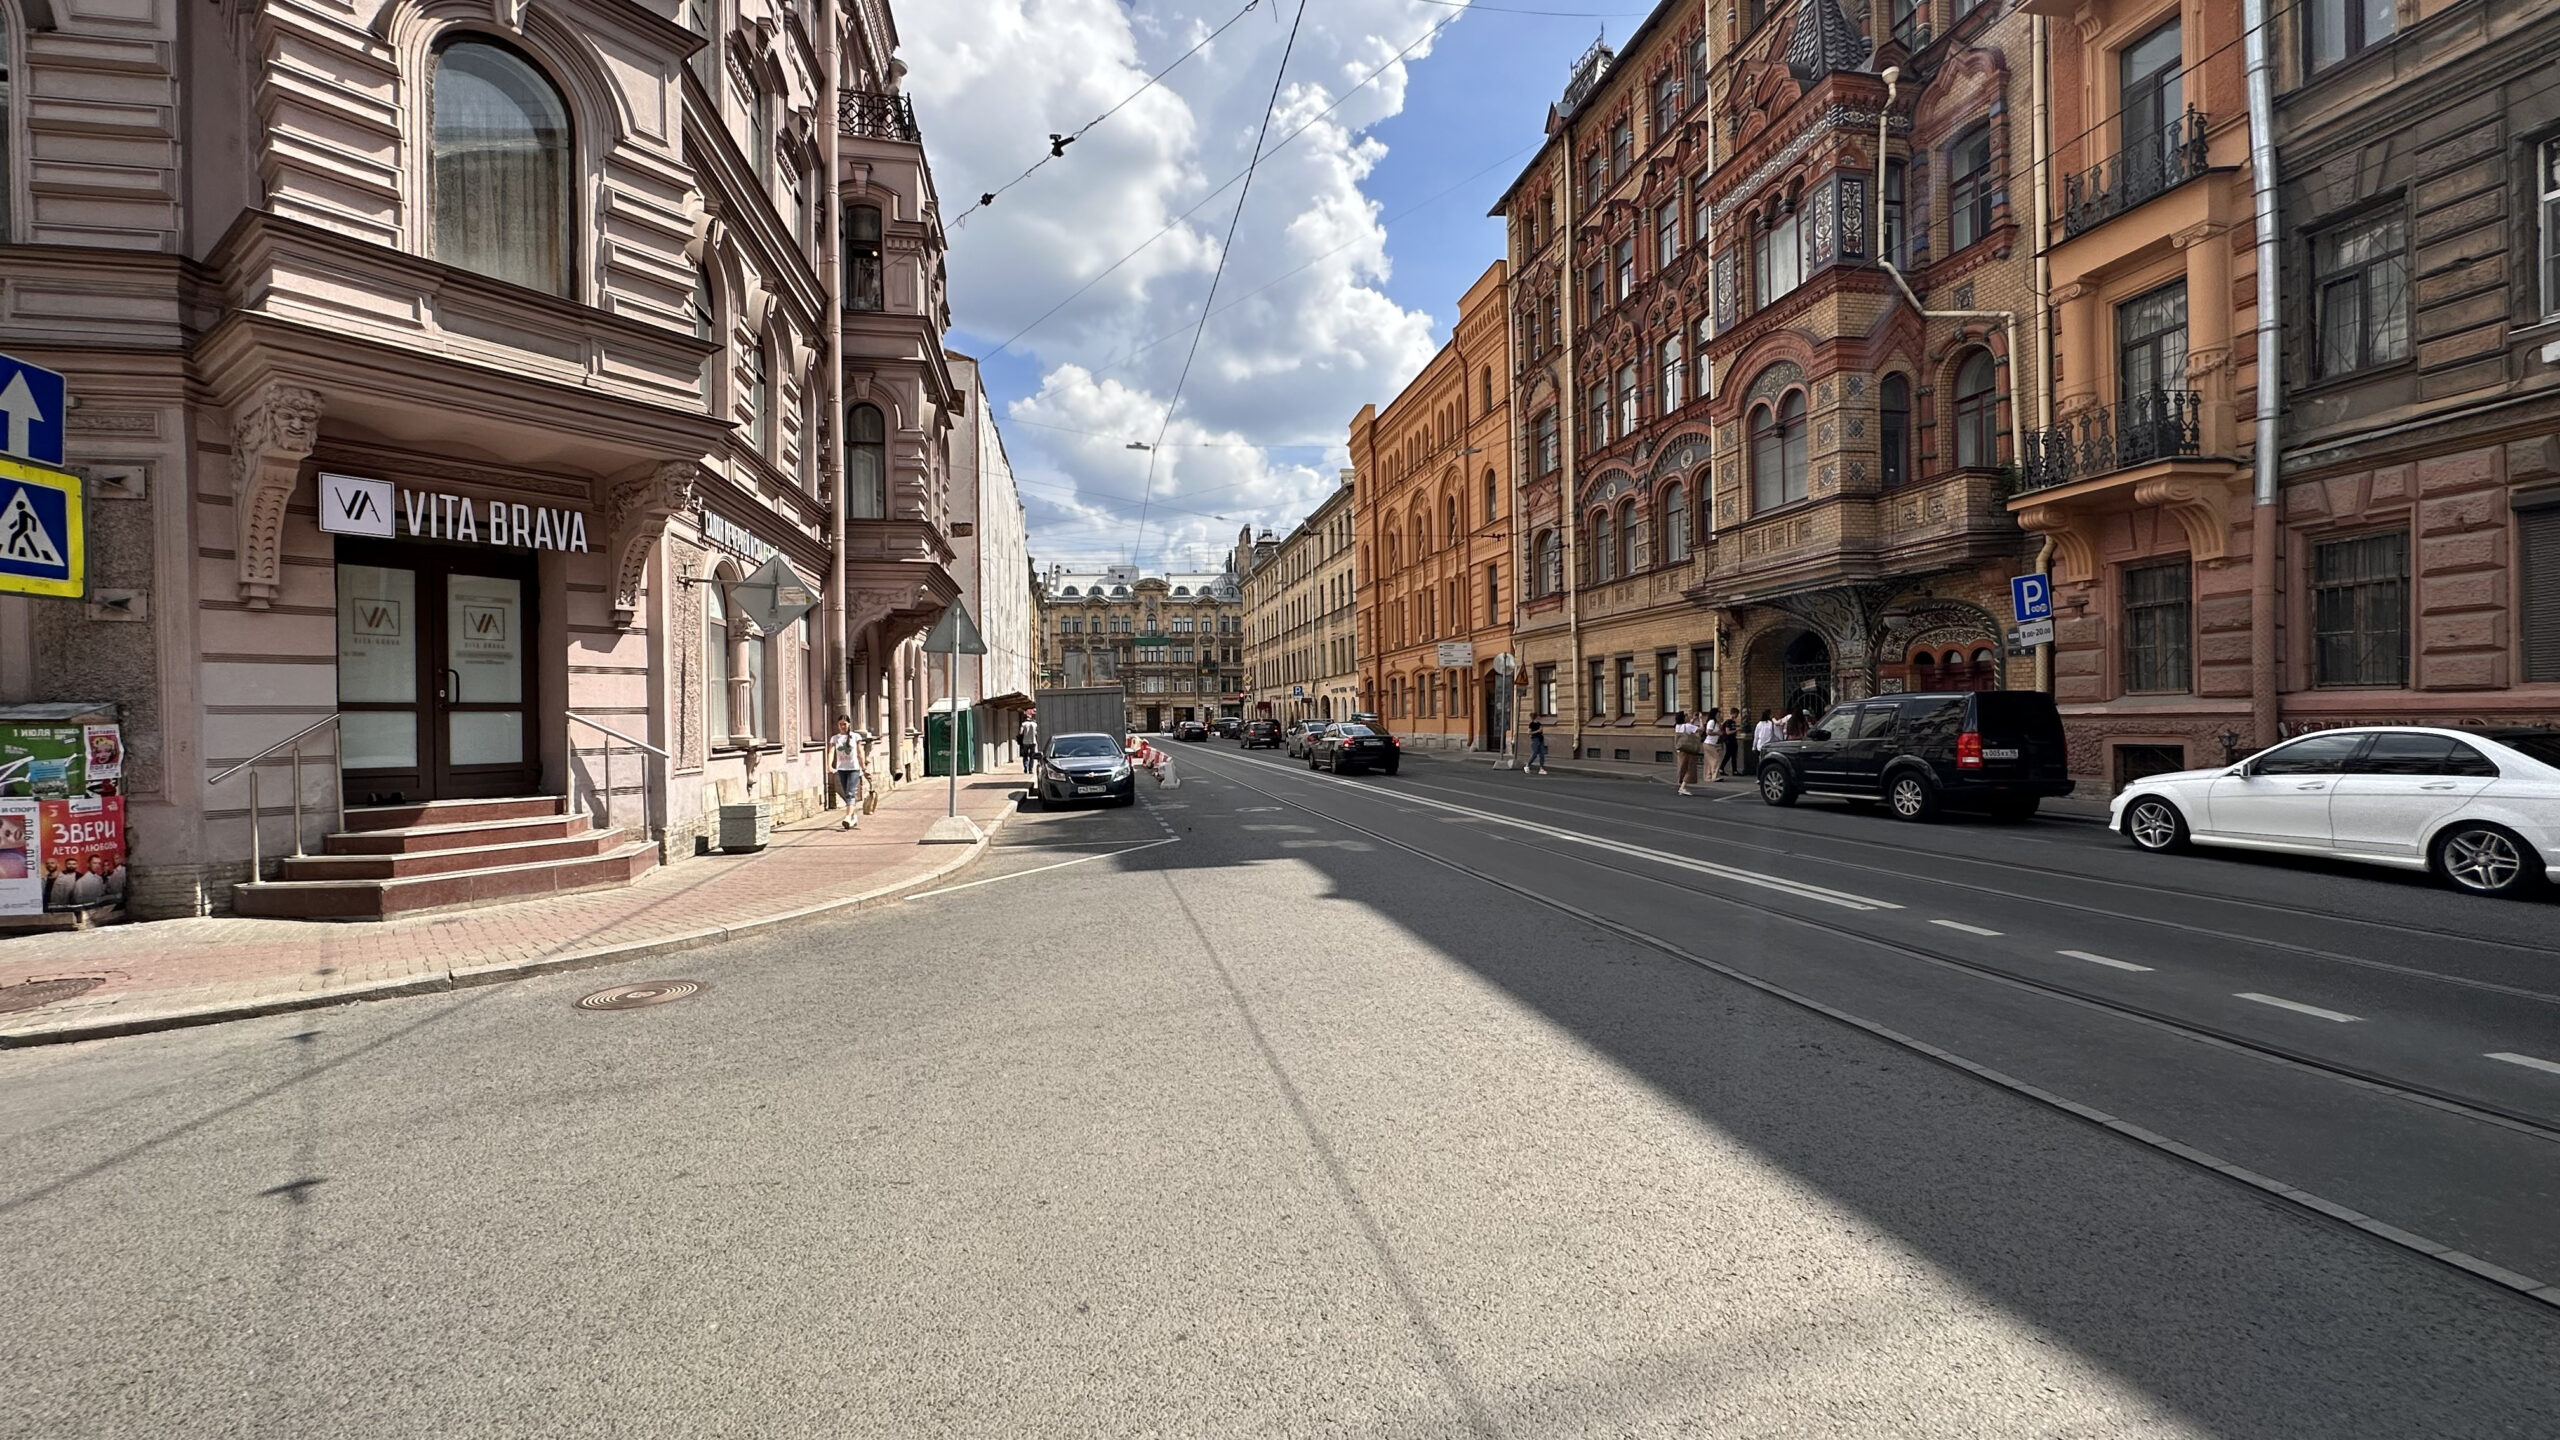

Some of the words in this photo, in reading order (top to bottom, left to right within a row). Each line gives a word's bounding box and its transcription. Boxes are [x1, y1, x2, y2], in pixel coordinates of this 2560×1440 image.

[403, 489, 478, 542] VITA
[489, 501, 589, 553] BRAVA
[2022, 580, 2043, 616] P
[21, 729, 51, 737] ИЮЛЯ
[52, 821, 116, 844] ЗВЕРИ
[52, 846, 79, 855] ЛЕТО
[84, 842, 118, 853] ЛЮБОВЬ
